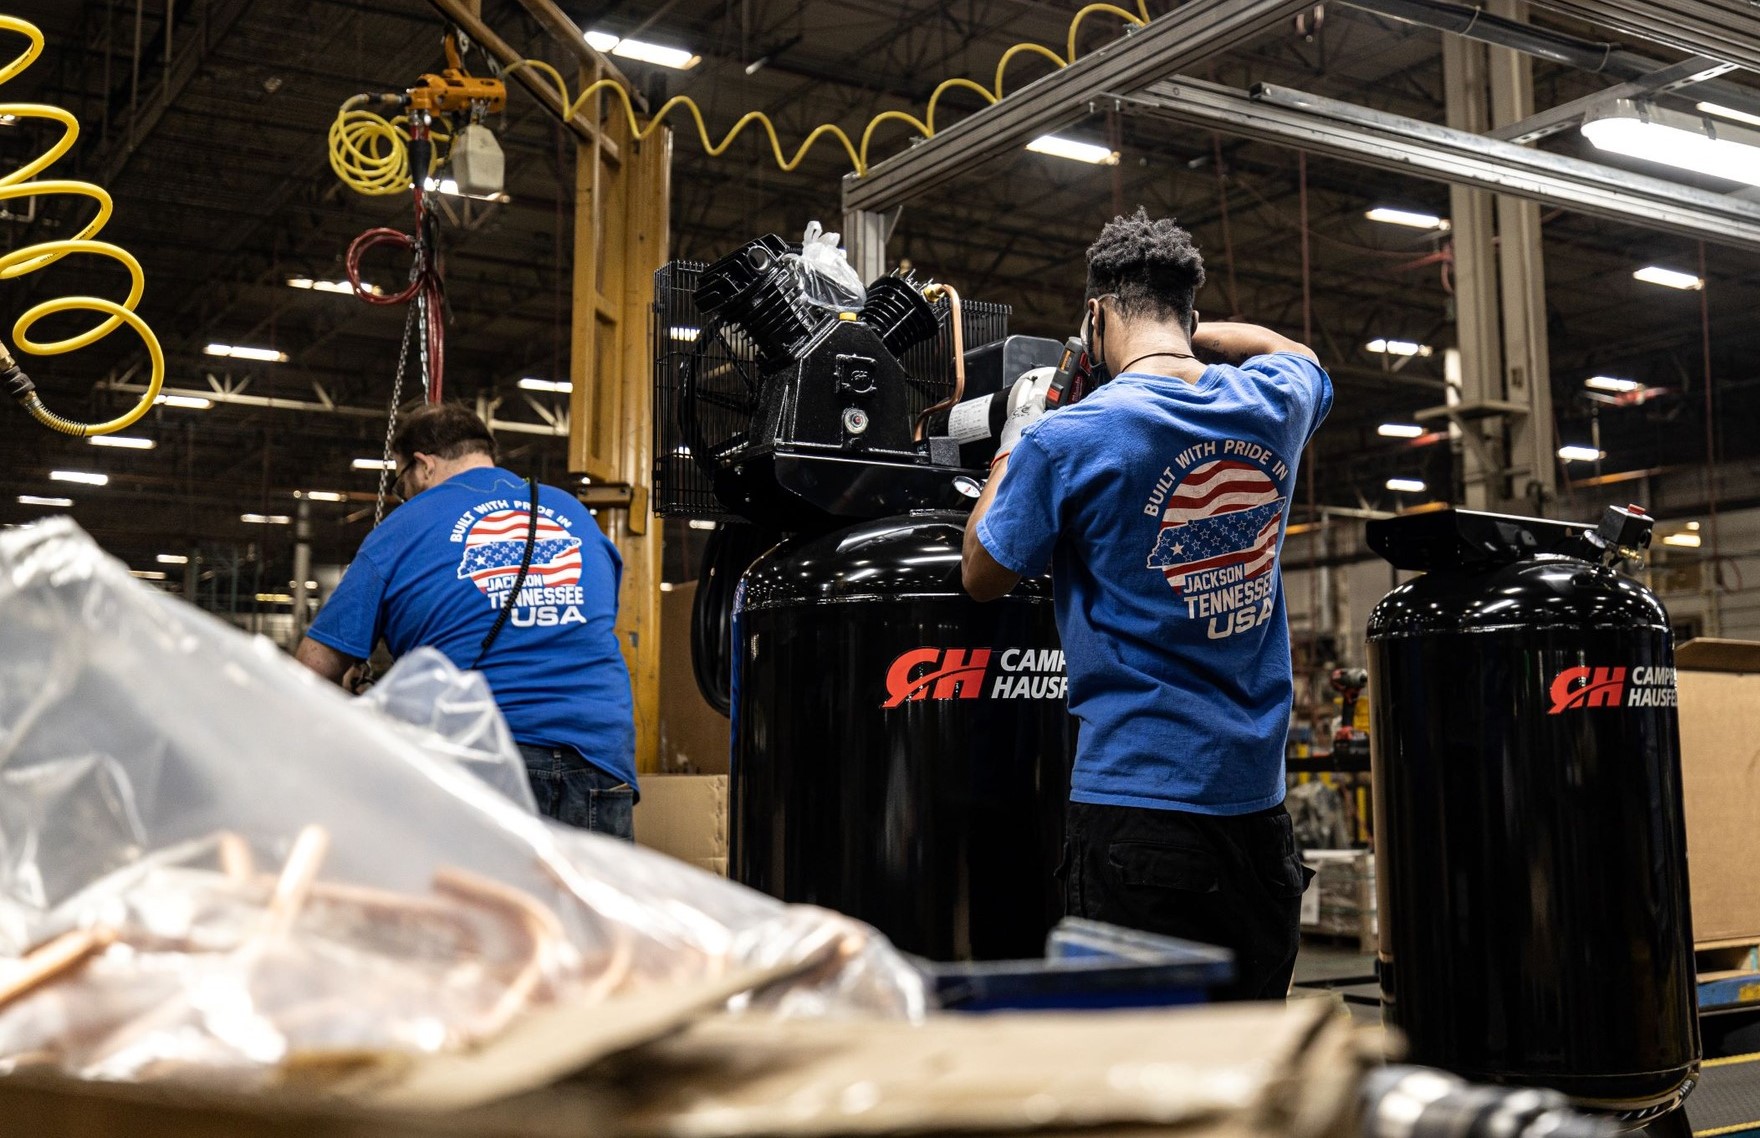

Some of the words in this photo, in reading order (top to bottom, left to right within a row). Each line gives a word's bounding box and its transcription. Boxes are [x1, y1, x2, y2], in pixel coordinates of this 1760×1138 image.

[1143, 466, 1176, 518] BUILT
[1174, 440, 1216, 470] WITH
[1223, 439, 1272, 465] PRIDE
[1271, 459, 1289, 482] IN
[450, 510, 476, 543] BUILT
[473, 499, 509, 515] WITH
[513, 500, 555, 518] PRDE
[556, 515, 572, 528] IN
[1183, 564, 1244, 594] JACKSON
[1183, 574, 1271, 619] TENNESSE
[510, 606, 587, 627] USA
[1207, 597, 1273, 640] USA
